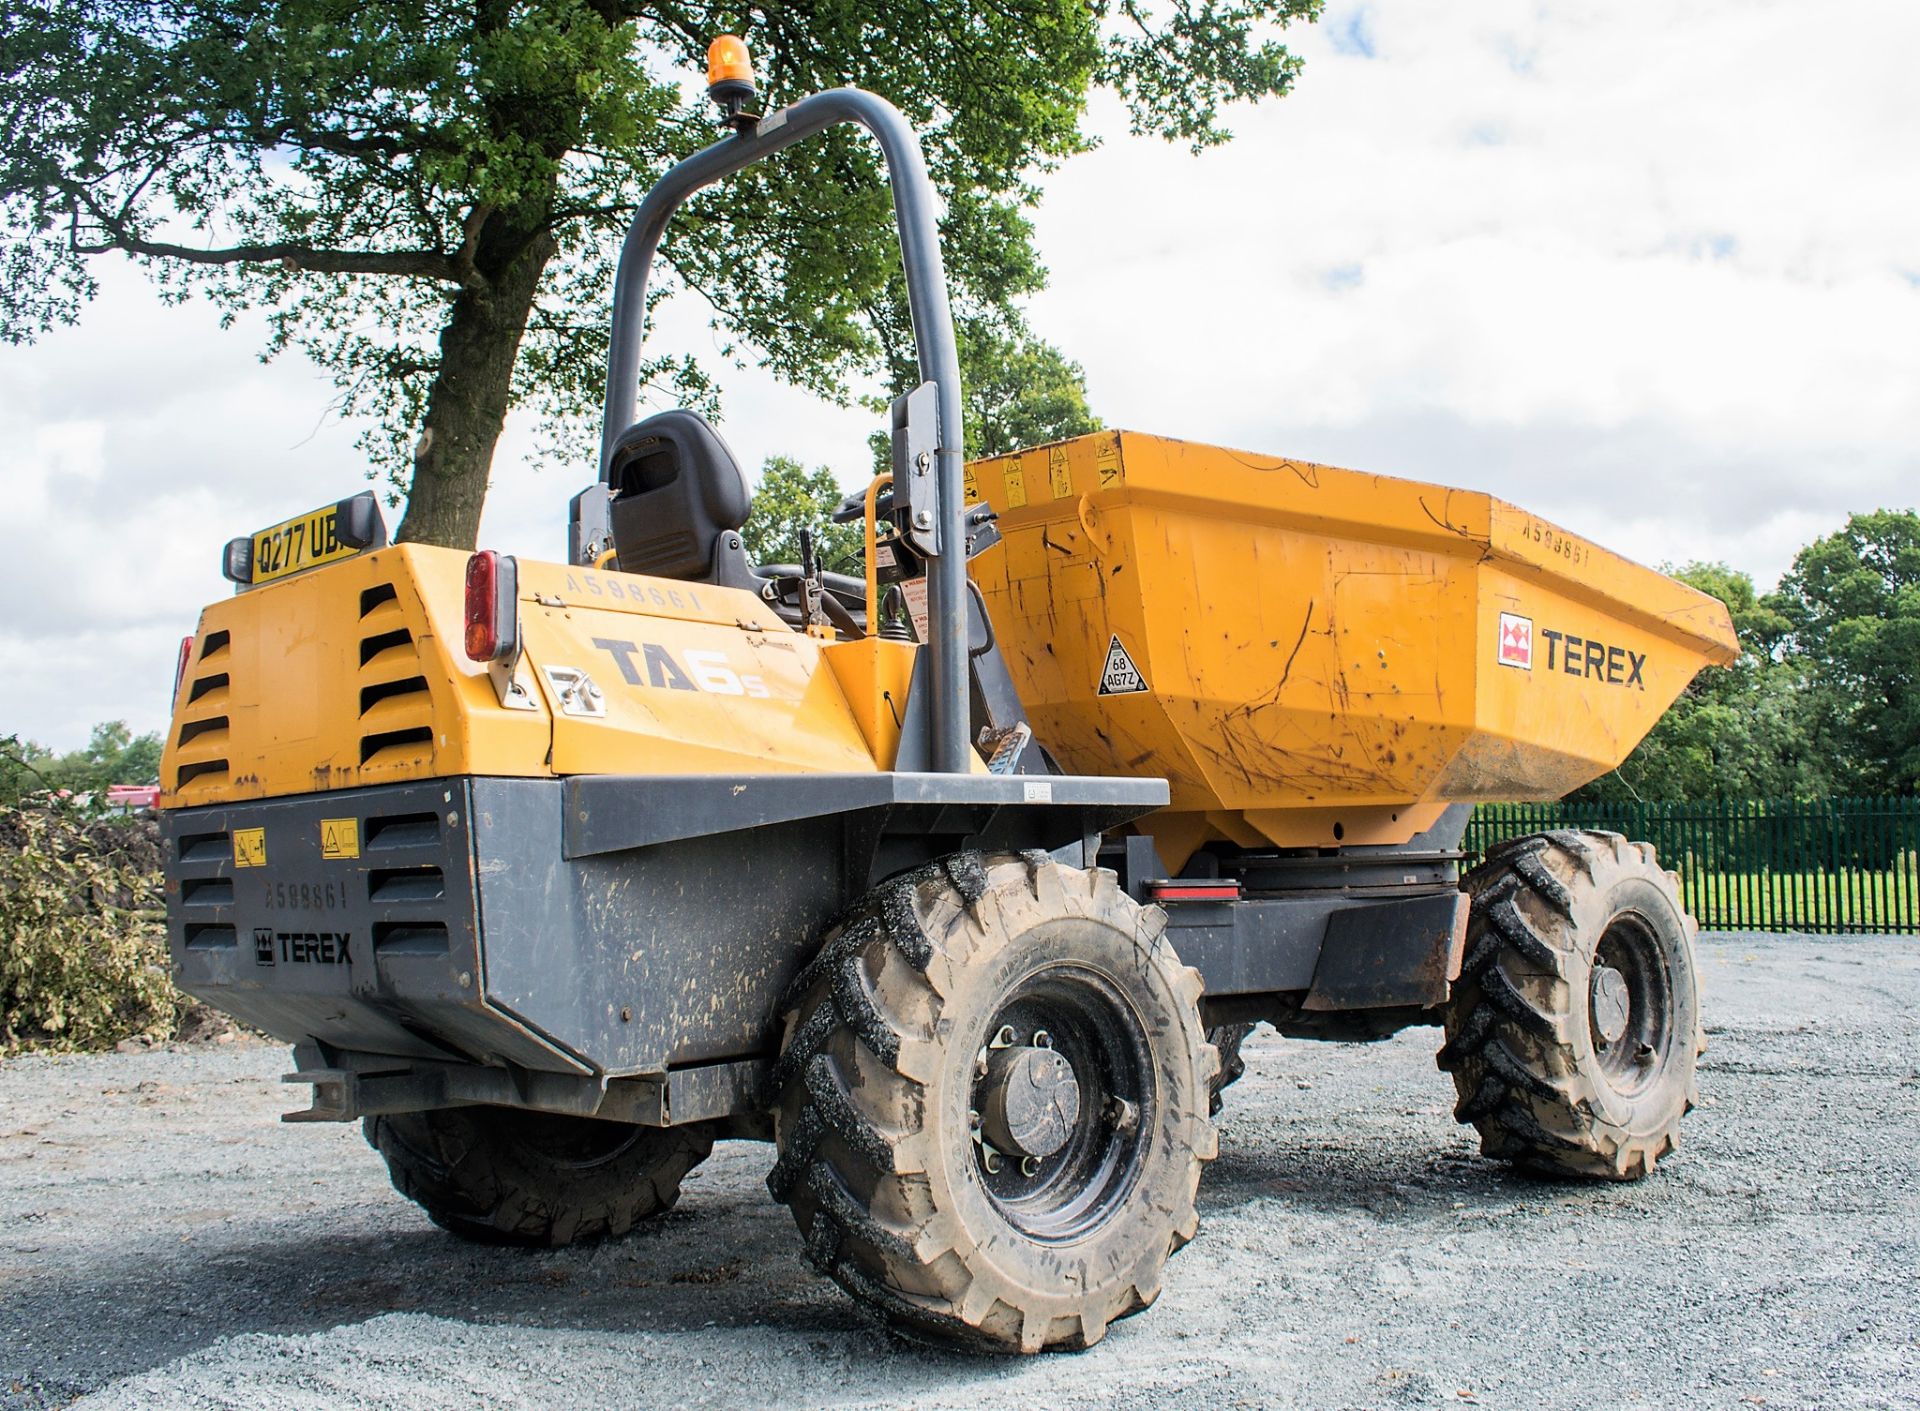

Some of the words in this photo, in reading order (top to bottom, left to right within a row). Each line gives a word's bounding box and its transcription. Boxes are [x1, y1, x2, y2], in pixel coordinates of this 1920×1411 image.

[260, 523, 305, 573] Q277
[311, 513, 345, 557] UB
[1113, 657, 1126, 671] 68
[1541, 628, 1647, 691] TEREX
[1107, 672, 1135, 687] AG7Z
[277, 932, 353, 965] TEREX
